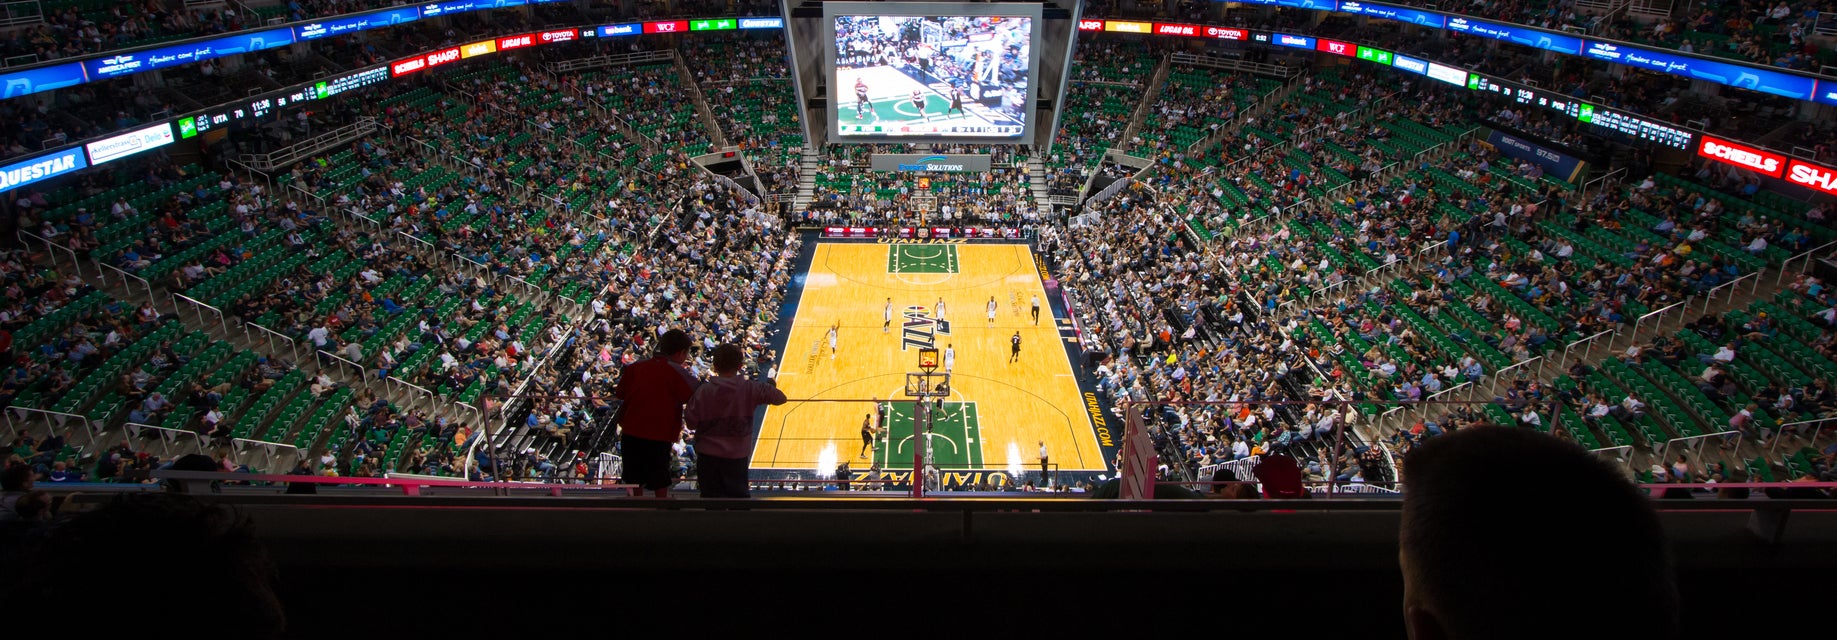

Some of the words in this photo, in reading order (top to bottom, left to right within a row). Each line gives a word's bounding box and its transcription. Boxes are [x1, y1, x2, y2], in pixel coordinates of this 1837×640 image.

[656, 23, 675, 31] WCF
[1160, 26, 1182, 34] LUCAS
[502, 38, 520, 48] LUCAS
[520, 36, 531, 44] OIL
[1328, 42, 1344, 52] WCF
[428, 50, 460, 66] SHARP
[394, 59, 424, 74] SCHEELS
[1488, 84, 1500, 92] UTA
[1552, 101, 1565, 111] POR
[213, 114, 228, 124] UTA
[234, 110, 244, 118] 70
[291, 92, 304, 102] POR
[1704, 142, 1780, 172] SCHEELS
[901, 304, 951, 352] JAZZ
[1084, 392, 1114, 446] UTAHJAZZ.COM
